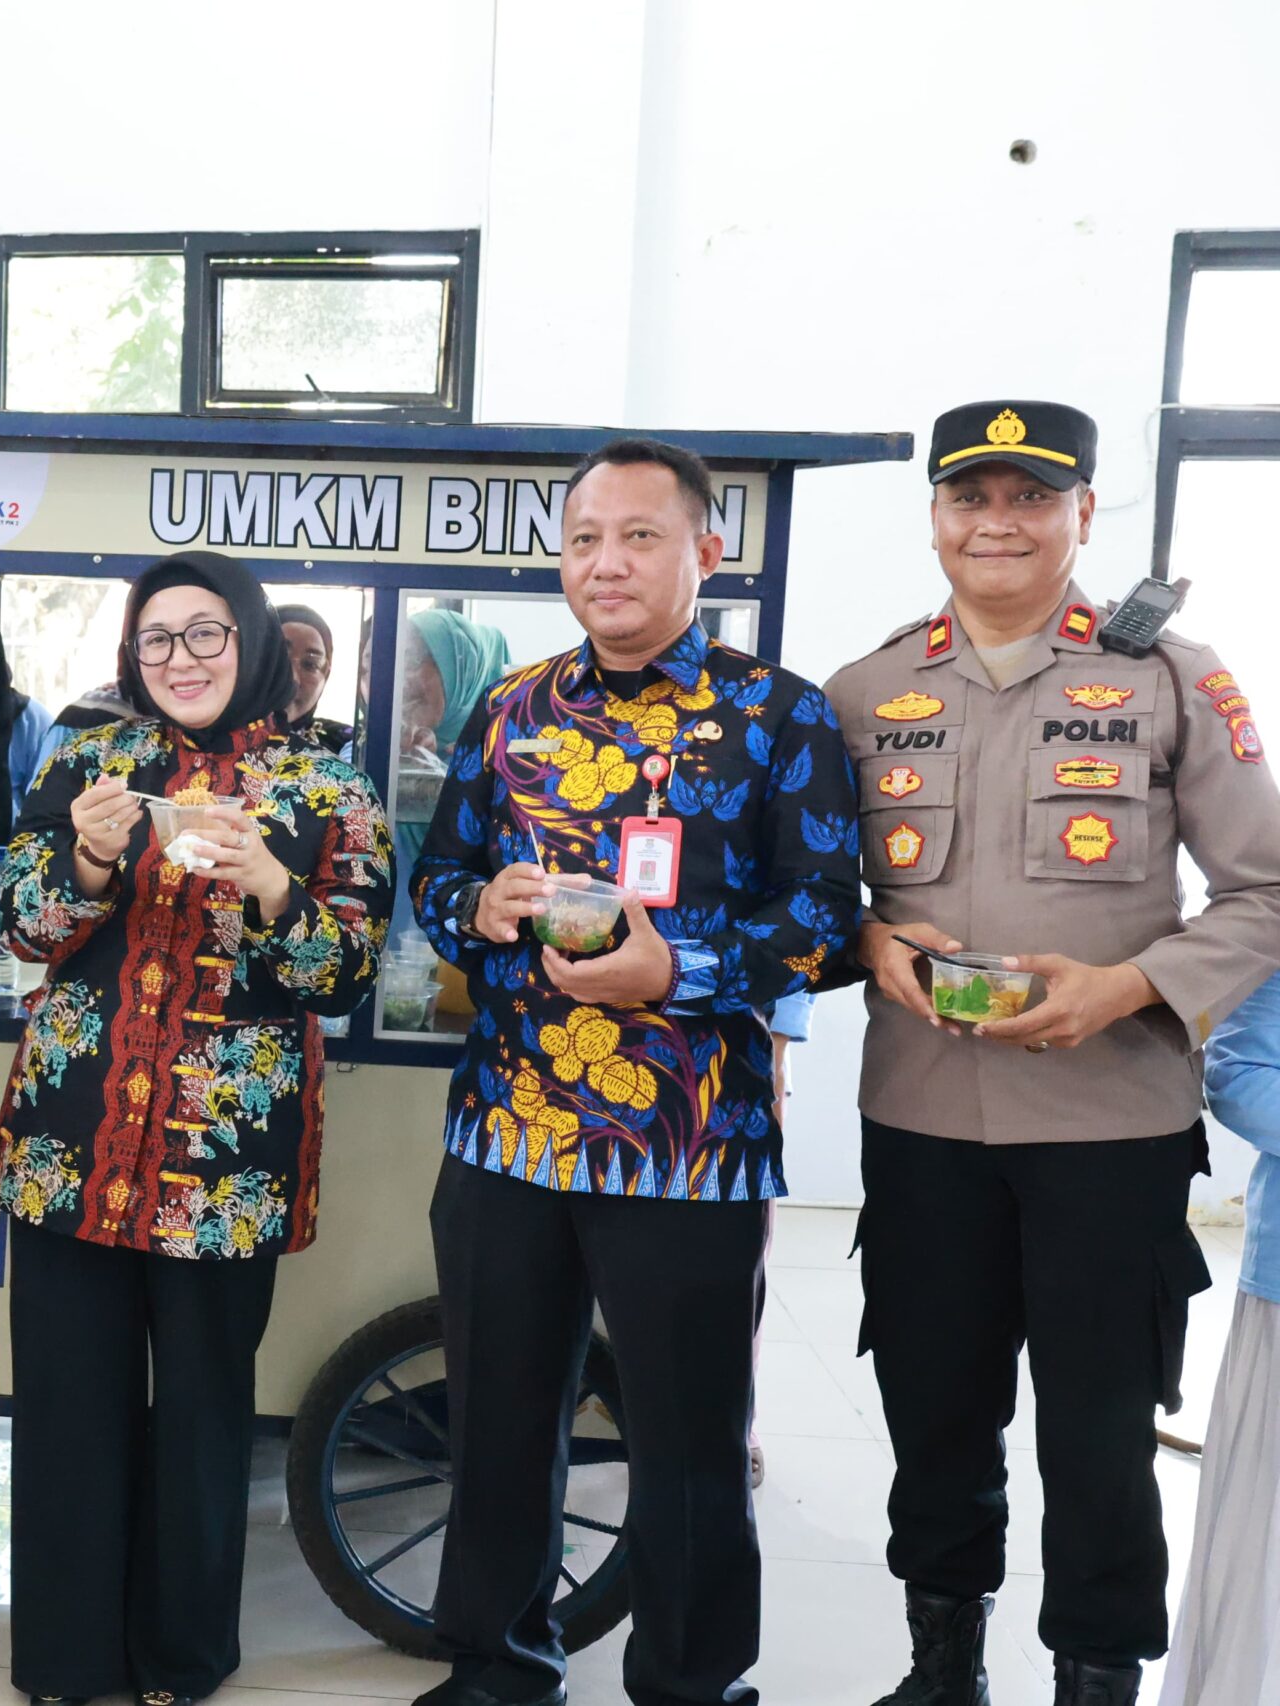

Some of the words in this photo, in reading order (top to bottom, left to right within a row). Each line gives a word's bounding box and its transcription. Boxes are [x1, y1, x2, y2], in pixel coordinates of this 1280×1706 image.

[148, 468, 403, 552] UMKM
[875, 729, 947, 752] YUDI
[1042, 719, 1138, 743] POLRI
